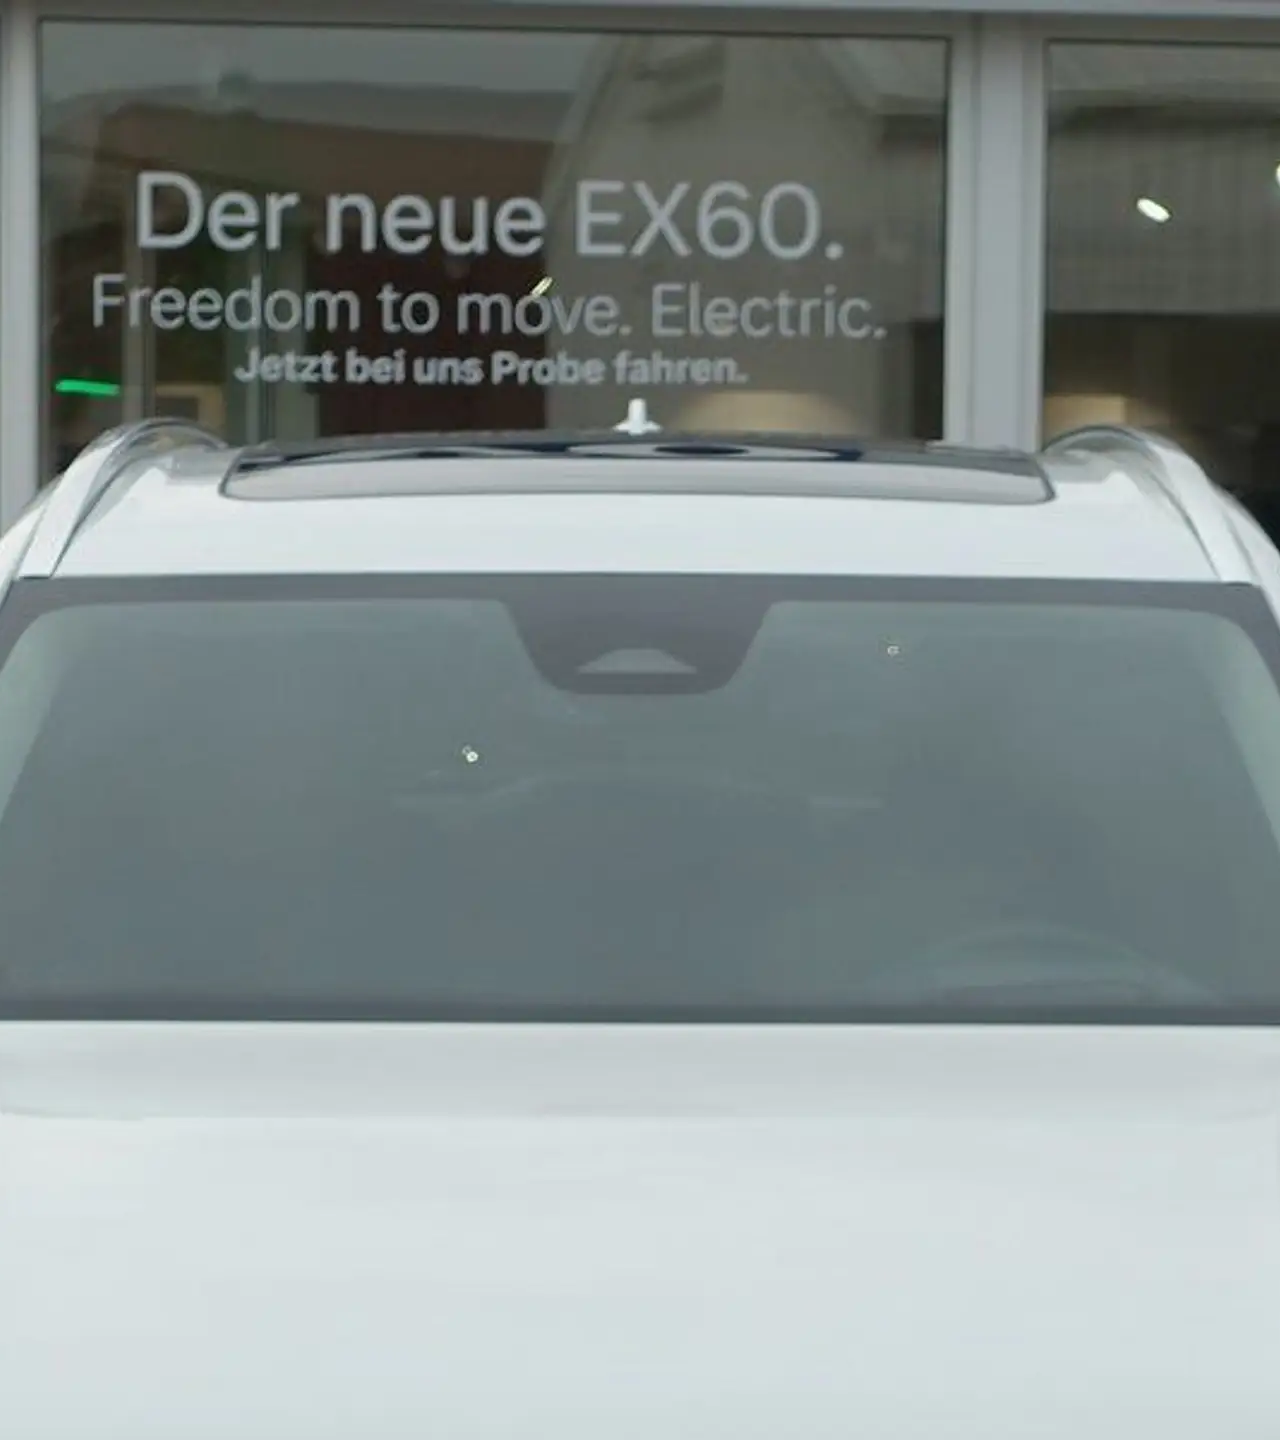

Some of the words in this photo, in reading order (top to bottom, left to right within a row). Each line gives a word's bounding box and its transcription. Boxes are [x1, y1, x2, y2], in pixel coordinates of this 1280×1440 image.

[136, 170, 300, 252] Der
[324, 192, 548, 257] neue
[575, 179, 845, 261] EX60.
[91, 272, 361, 332] Freedom
[376, 281, 441, 335] to
[456, 292, 632, 338] move.
[651, 281, 889, 341] Electric.
[233, 345, 339, 385] Jetzt
[344, 347, 407, 385] bei
[412, 354, 485, 387] uns
[490, 349, 607, 386] Probe
[612, 348, 750, 386] fahren.
